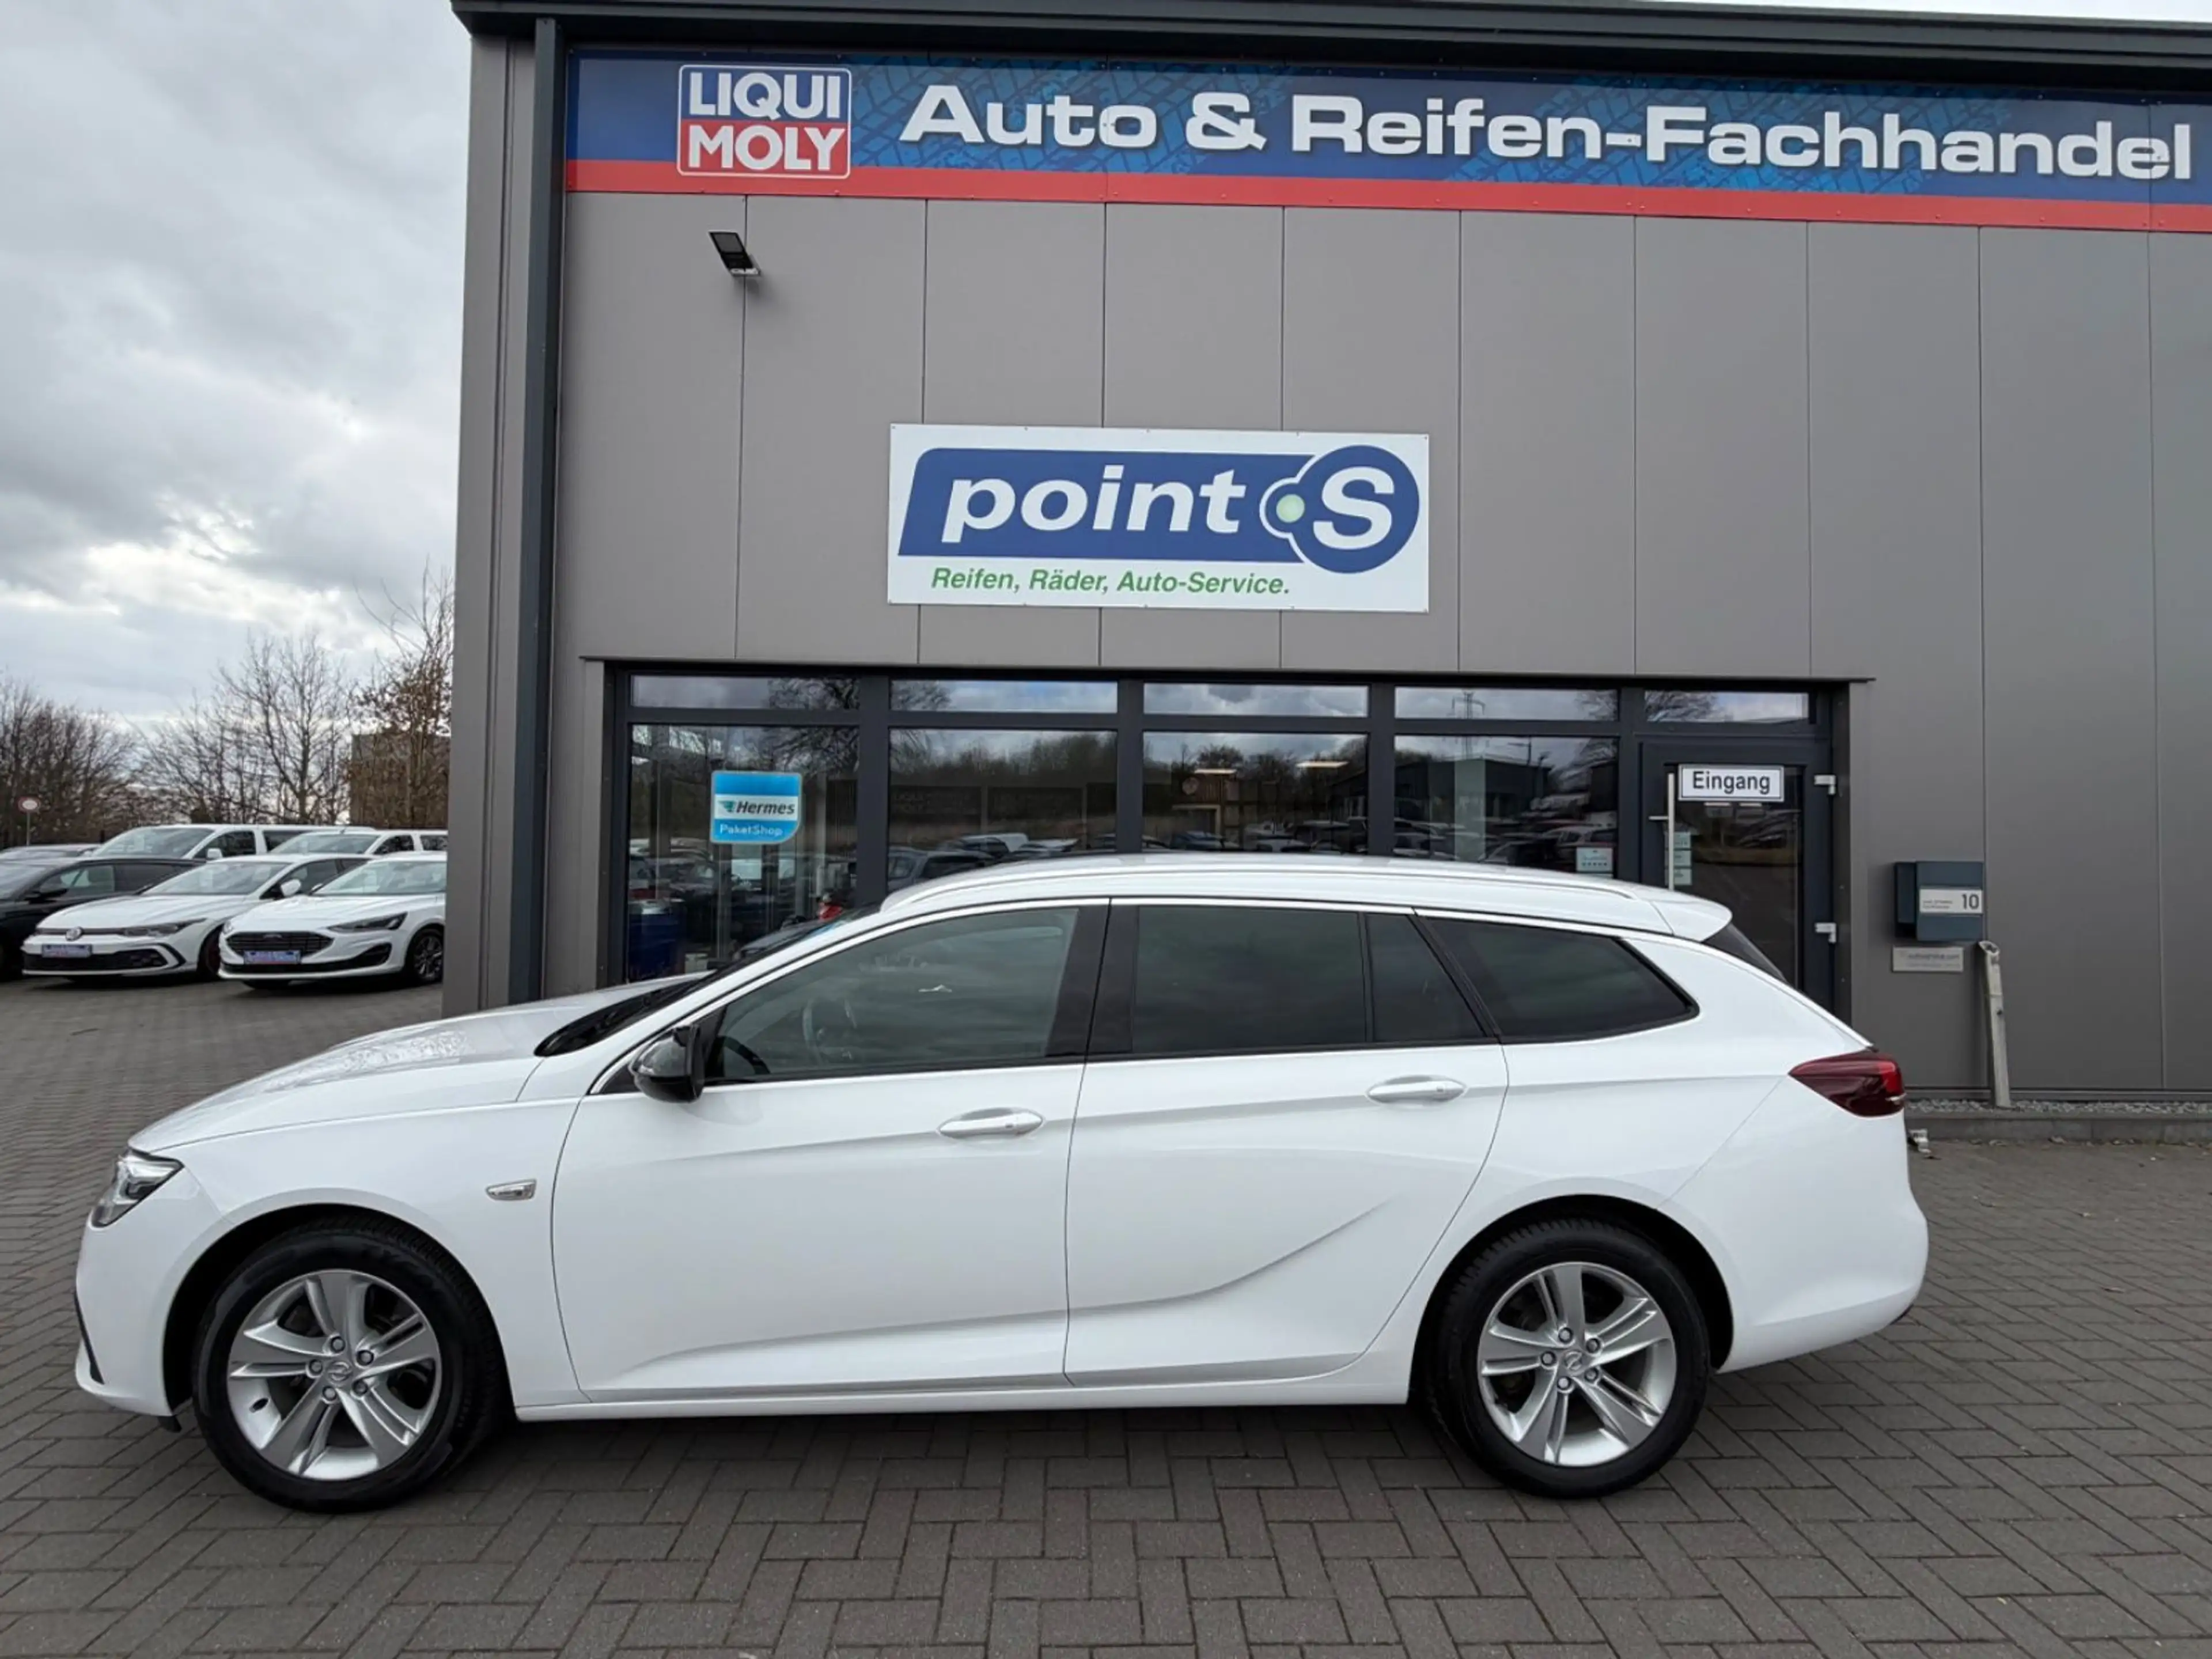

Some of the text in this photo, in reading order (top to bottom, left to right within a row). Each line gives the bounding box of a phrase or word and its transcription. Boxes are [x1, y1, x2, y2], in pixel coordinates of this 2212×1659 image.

[689, 72, 841, 120] LIQUI
[689, 124, 847, 171] MOLY
[899, 84, 2191, 180] Auto & Reifen-Fachhandel
[941, 464, 1395, 550] point S
[931, 567, 1291, 596] Reifen, Räder, Auto-Service.
[1692, 770, 1771, 794] Eingang
[736, 801, 795, 815] Hermes
[1961, 893, 1980, 910] 10
